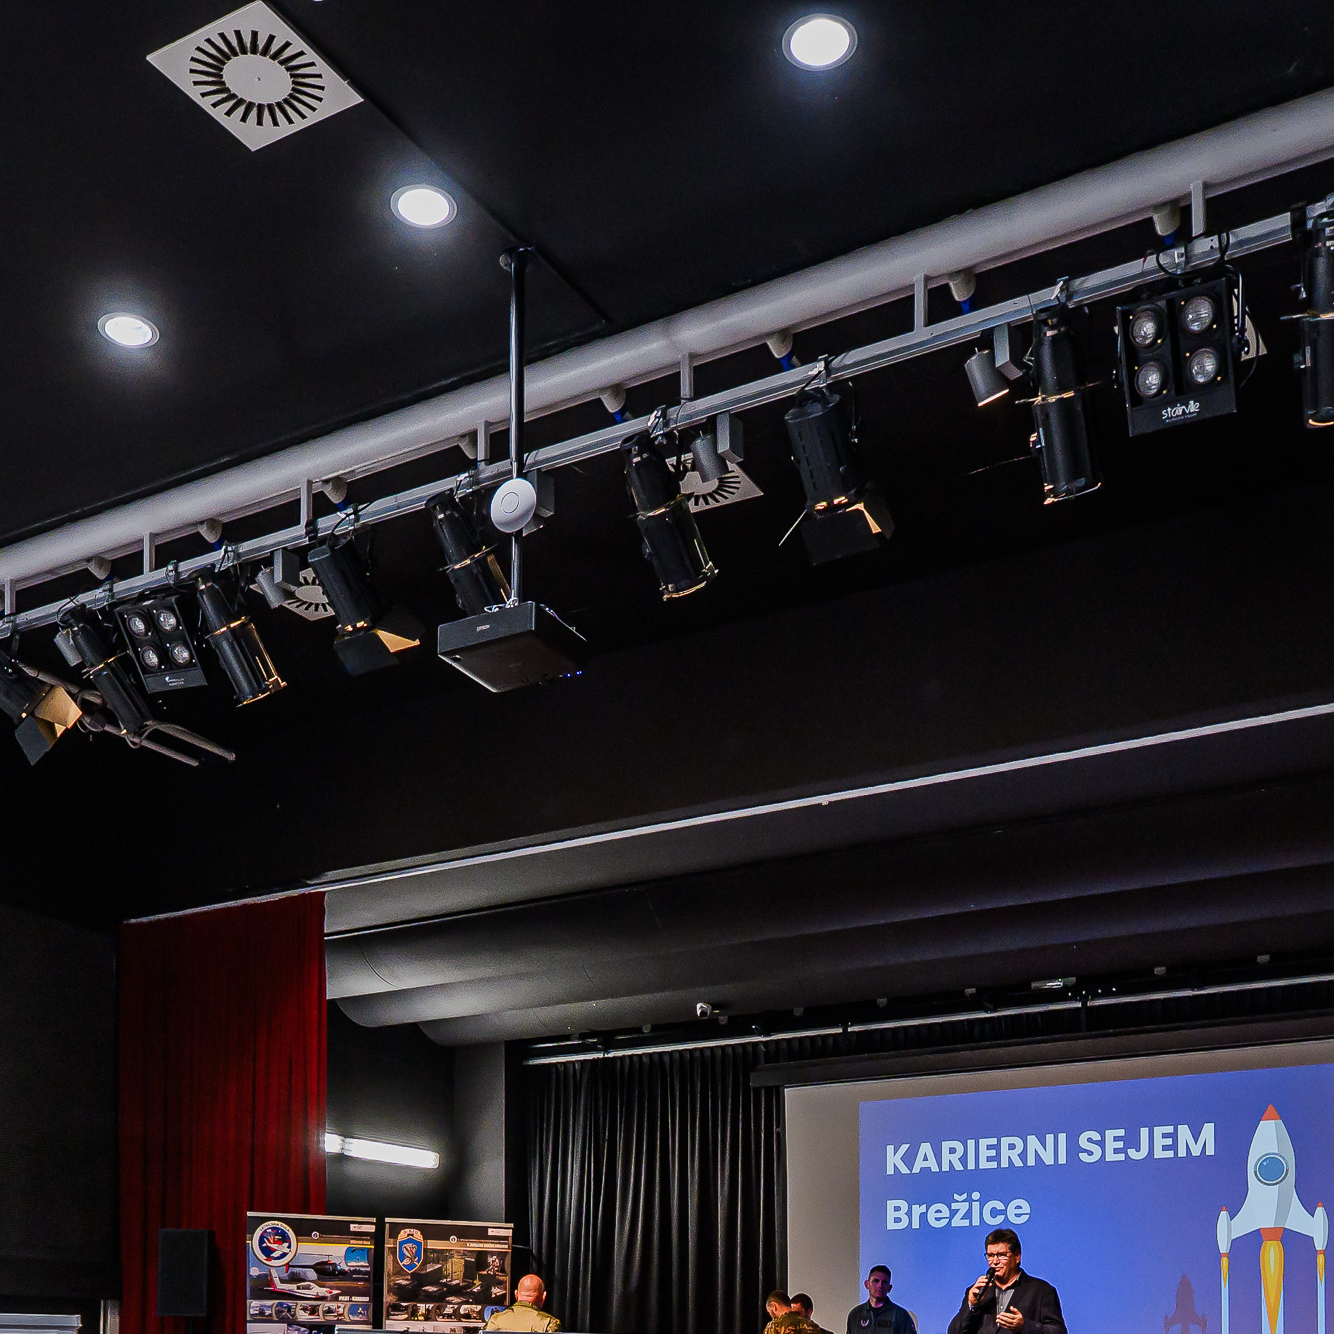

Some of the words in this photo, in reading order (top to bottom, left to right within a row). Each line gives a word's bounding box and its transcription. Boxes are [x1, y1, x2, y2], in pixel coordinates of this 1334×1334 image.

[885, 1132, 1067, 1175] KARIERNI
[1078, 1122, 1216, 1164] SEJEM
[885, 1191, 1031, 1231] Brežice
